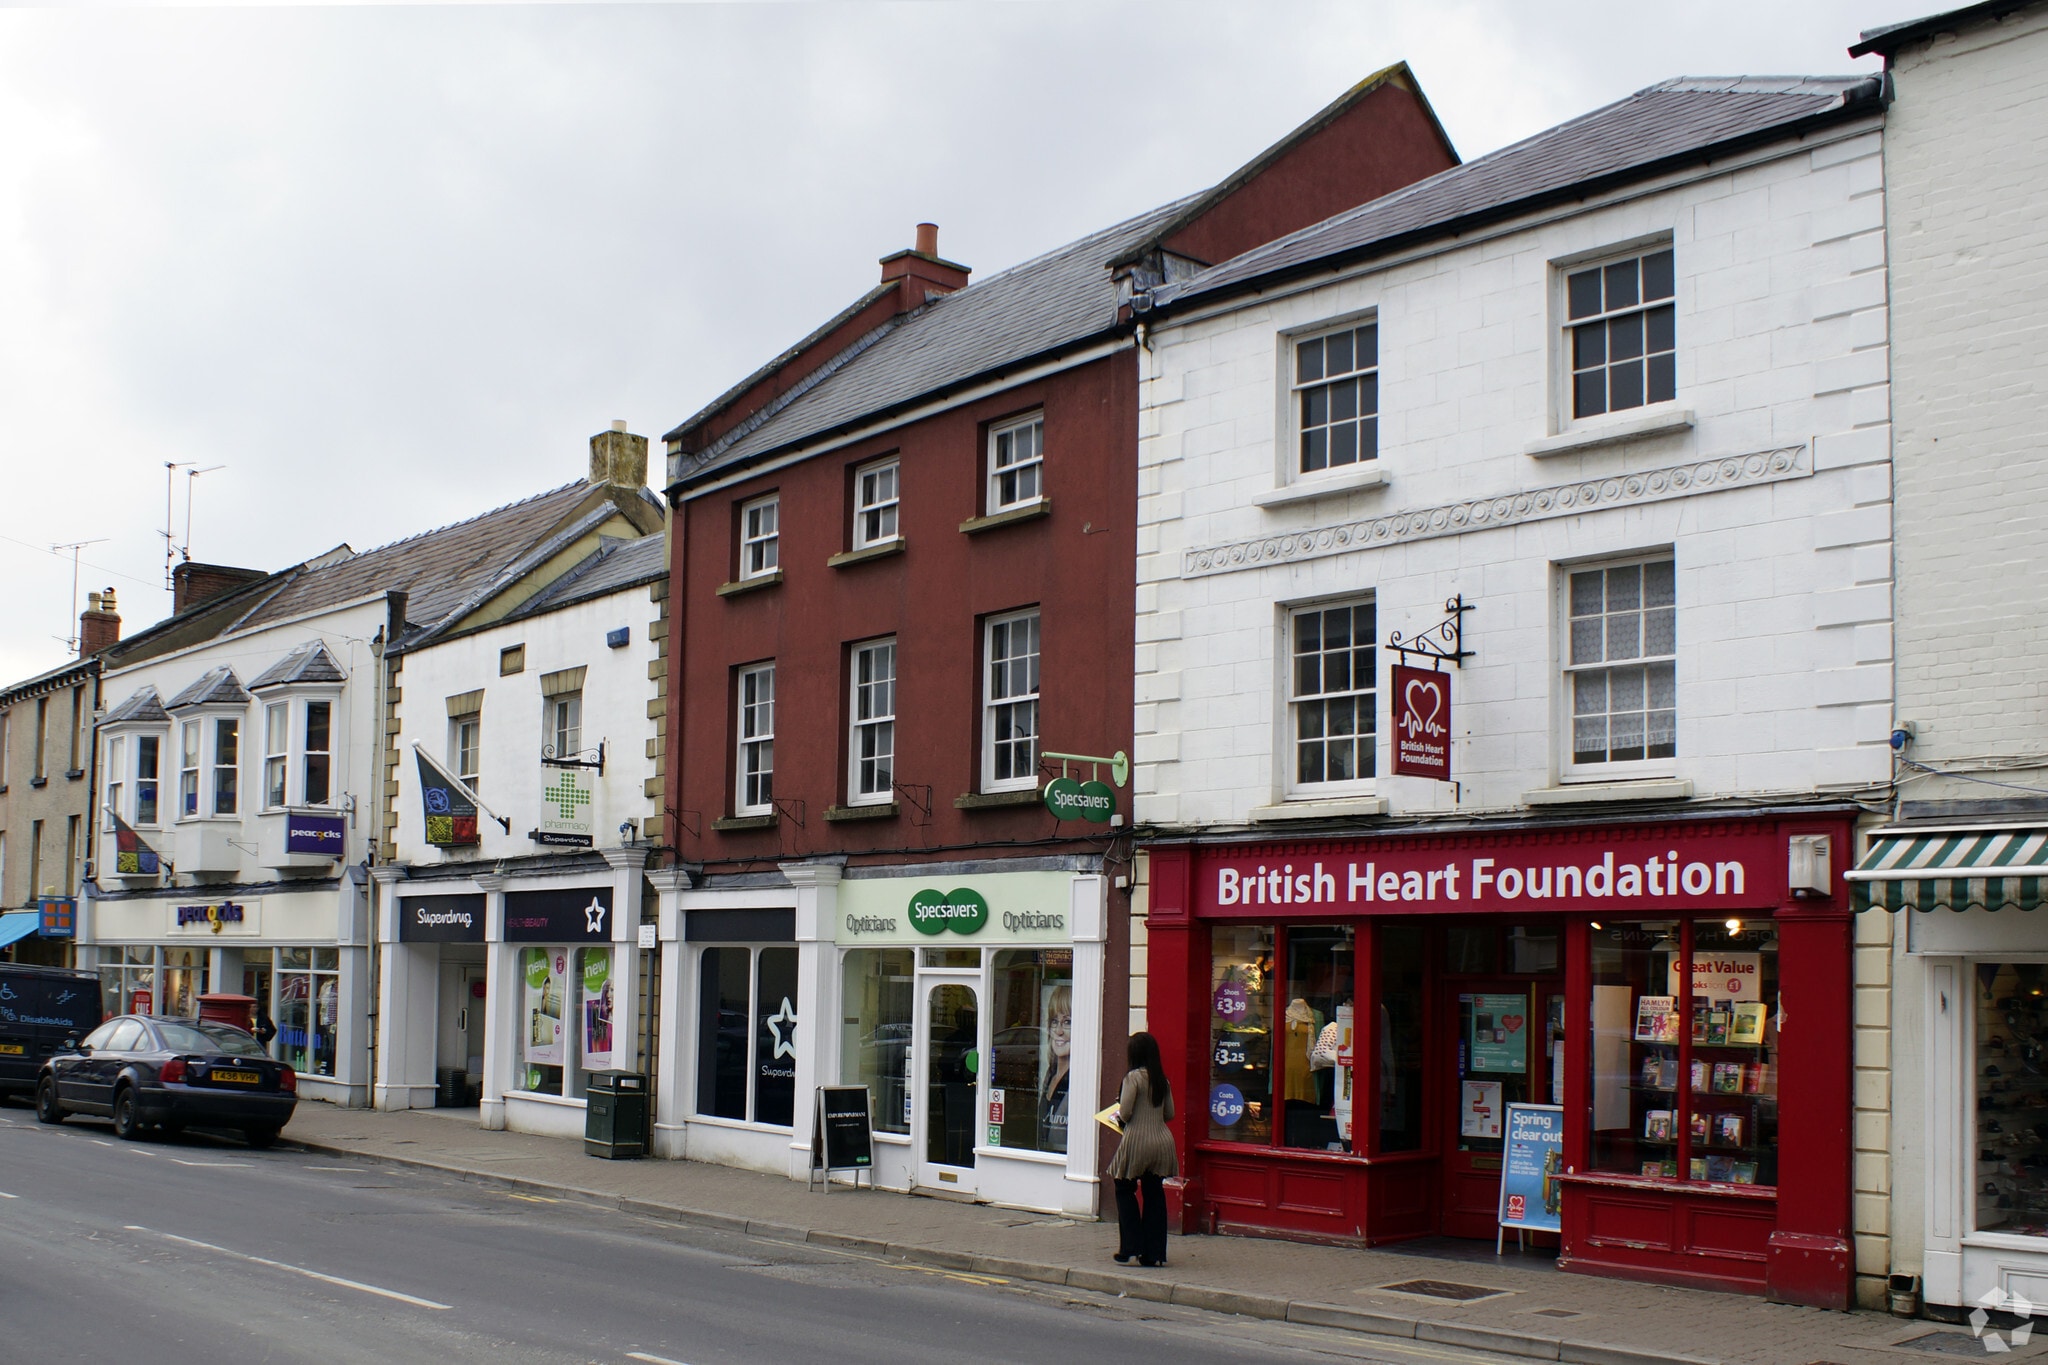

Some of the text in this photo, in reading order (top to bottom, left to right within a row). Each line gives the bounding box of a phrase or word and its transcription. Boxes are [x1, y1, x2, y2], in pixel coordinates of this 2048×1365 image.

[1401, 741, 1444, 755] British Heart
[1401, 752, 1444, 767] Foundation
[1054, 790, 1110, 809] Specsavers
[544, 820, 591, 832] pharmacy
[291, 829, 342, 841] peacocks
[543, 834, 590, 846] Superdrug
[1218, 850, 1745, 905] British Heart Foundation
[177, 901, 244, 934] peacocks
[417, 908, 473, 928] Superdrug
[915, 902, 978, 922] Specsavers
[846, 914, 897, 935] Opticians
[1003, 911, 1064, 934] Opticians
[527, 958, 547, 976] new
[585, 959, 607, 979] new
[1673, 960, 1754, 973] Geat Value
[1217, 998, 1246, 1014] £3.99
[1640, 999, 1671, 1007] HAMLYN
[20, 1014, 73, 1026] DisableAids
[1215, 1048, 1245, 1065] £3.25
[1211, 1101, 1243, 1117] £6.99
[1513, 1112, 1552, 1129] Spring
[1511, 1128, 1563, 1143] clear out
